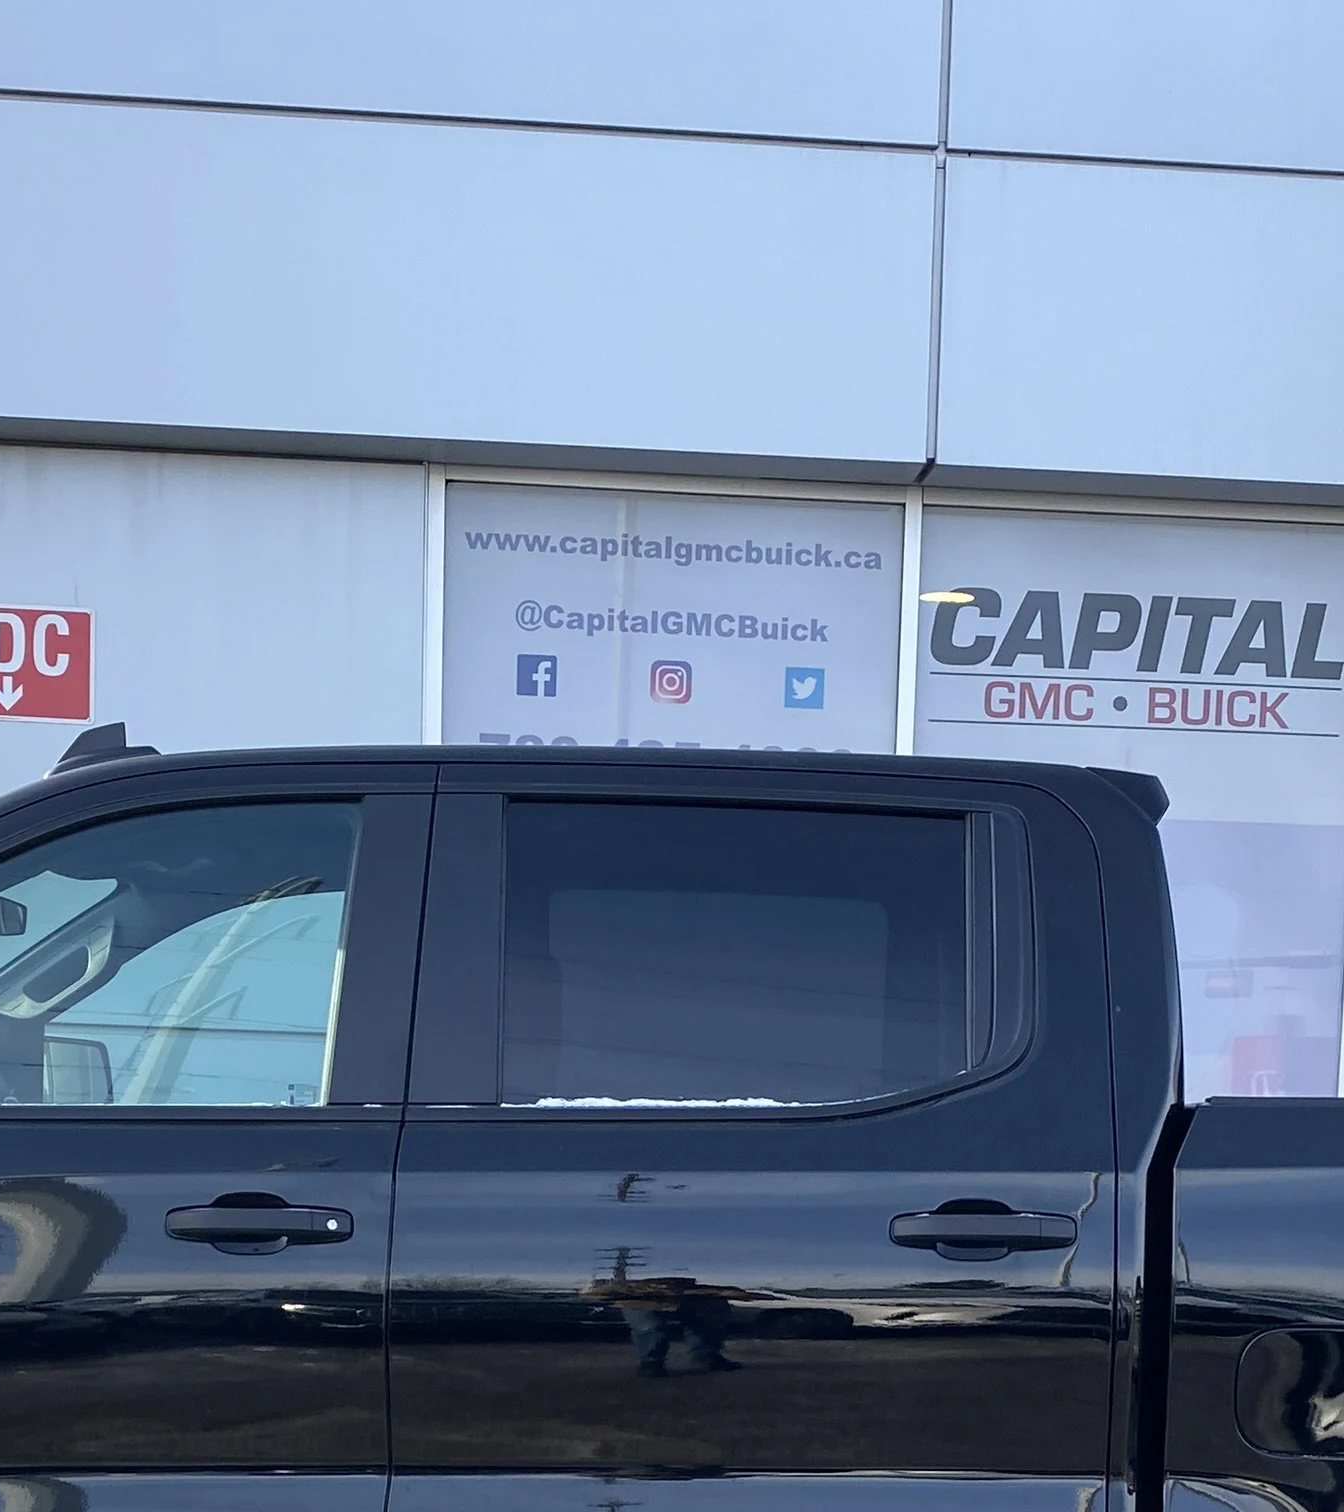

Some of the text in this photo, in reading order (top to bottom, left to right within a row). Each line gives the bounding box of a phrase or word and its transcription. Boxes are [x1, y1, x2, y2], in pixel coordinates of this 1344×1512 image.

[464, 531, 883, 570] www.capitalgmcbuick.ca
[515, 600, 829, 642] @CapitalGMCBuick
[930, 587, 1344, 680] CAPITAL
[983, 680, 1290, 729] GMC BUICK
